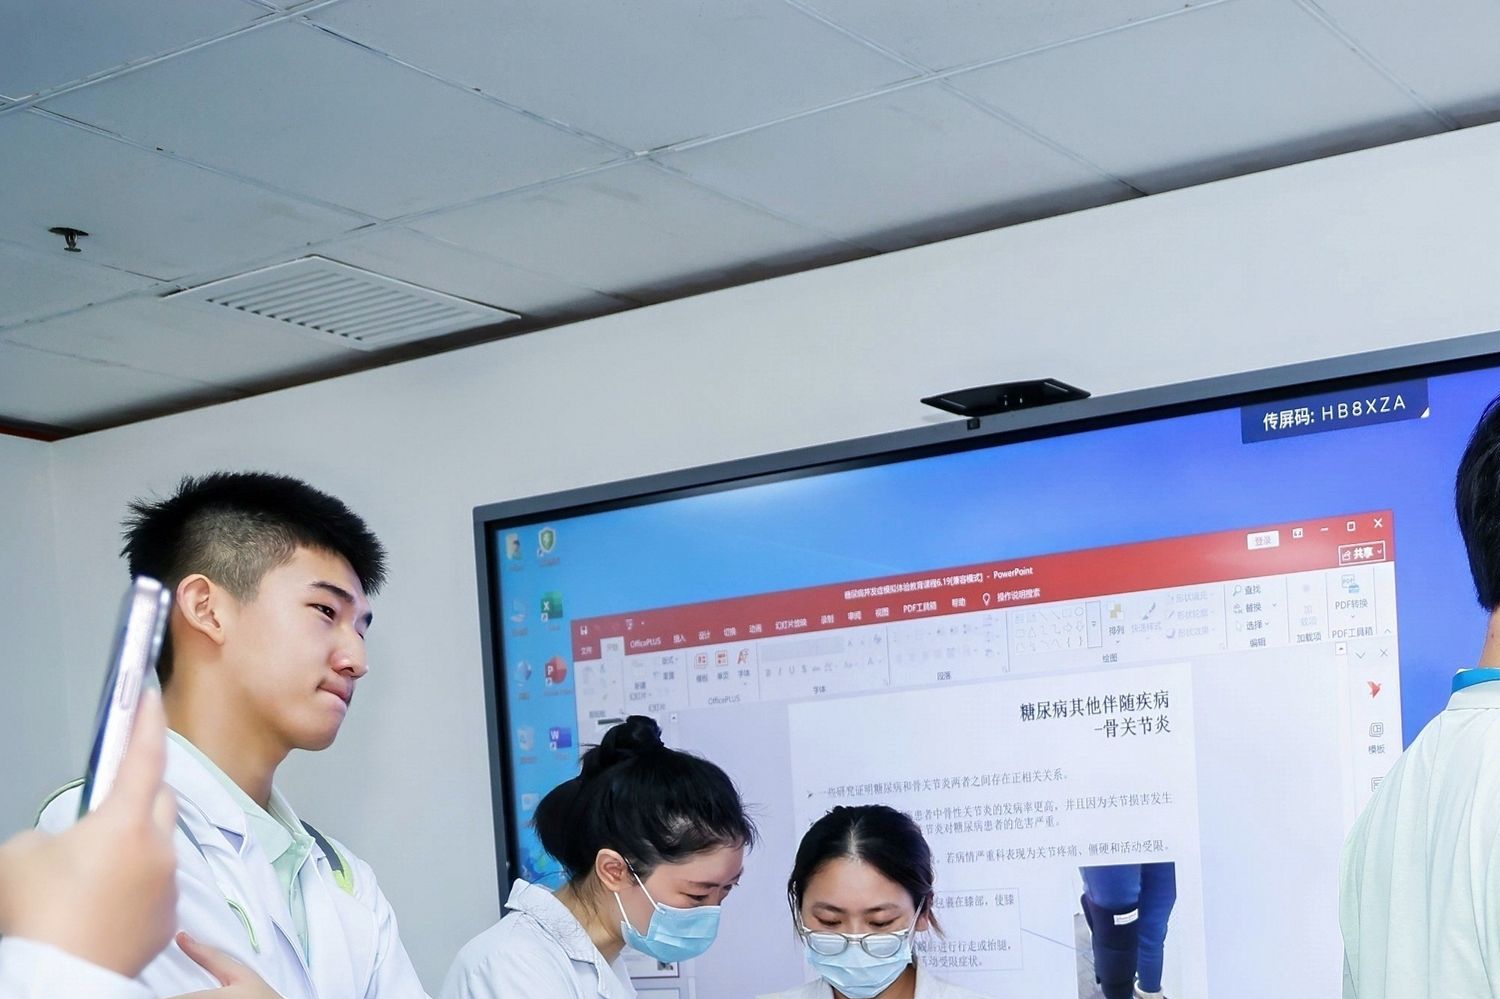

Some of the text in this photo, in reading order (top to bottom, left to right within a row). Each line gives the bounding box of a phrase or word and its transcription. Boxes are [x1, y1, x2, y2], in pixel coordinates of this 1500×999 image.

[1321, 394, 1406, 422] HB8XZA
[1352, 546, 1374, 561] 共享
[993, 566, 1034, 580] PowerPoint
[1245, 584, 1262, 595] 查找
[1246, 602, 1262, 613] 替换
[1335, 597, 1369, 610] PDF转换
[1109, 625, 1125, 636] 排列
[1246, 619, 1263, 631] 选择
[1297, 631, 1322, 644] 加载项
[1331, 627, 1374, 640] PDF工具箱
[1250, 637, 1267, 648] 编辑
[1102, 652, 1118, 663] 绘图
[1020, 690, 1170, 722] 糖尿病其他伴随疾病
[1368, 744, 1386, 755] 模板
